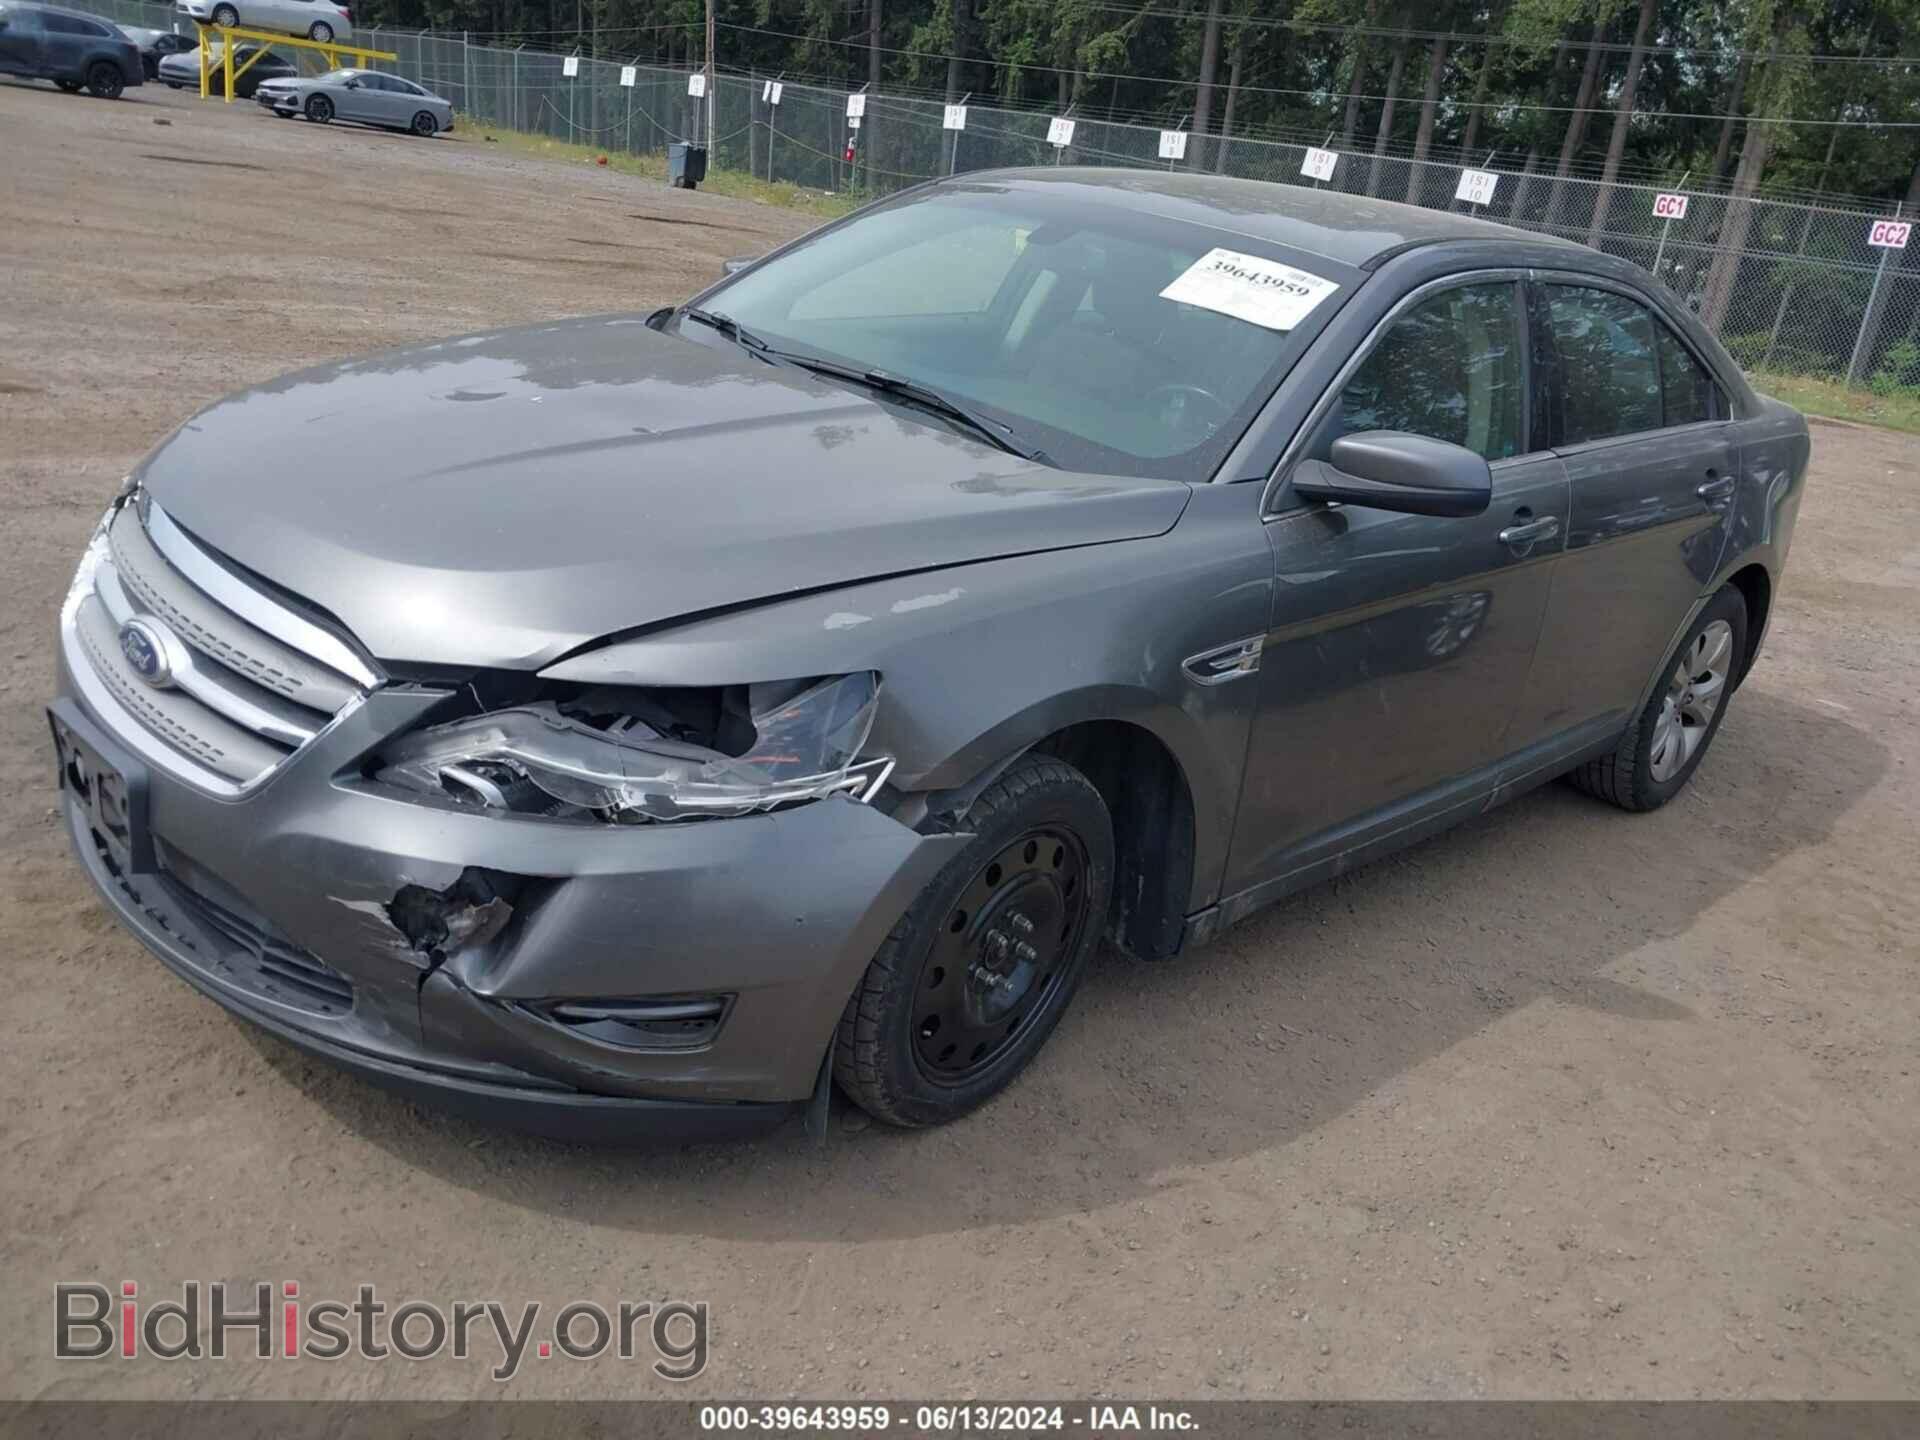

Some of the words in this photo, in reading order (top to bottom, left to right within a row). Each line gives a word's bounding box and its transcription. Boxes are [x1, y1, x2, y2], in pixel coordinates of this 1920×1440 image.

[1656, 198, 1684, 215] GC1
[1872, 223, 1907, 245] GC2
[1206, 260, 1311, 297] 39643959
